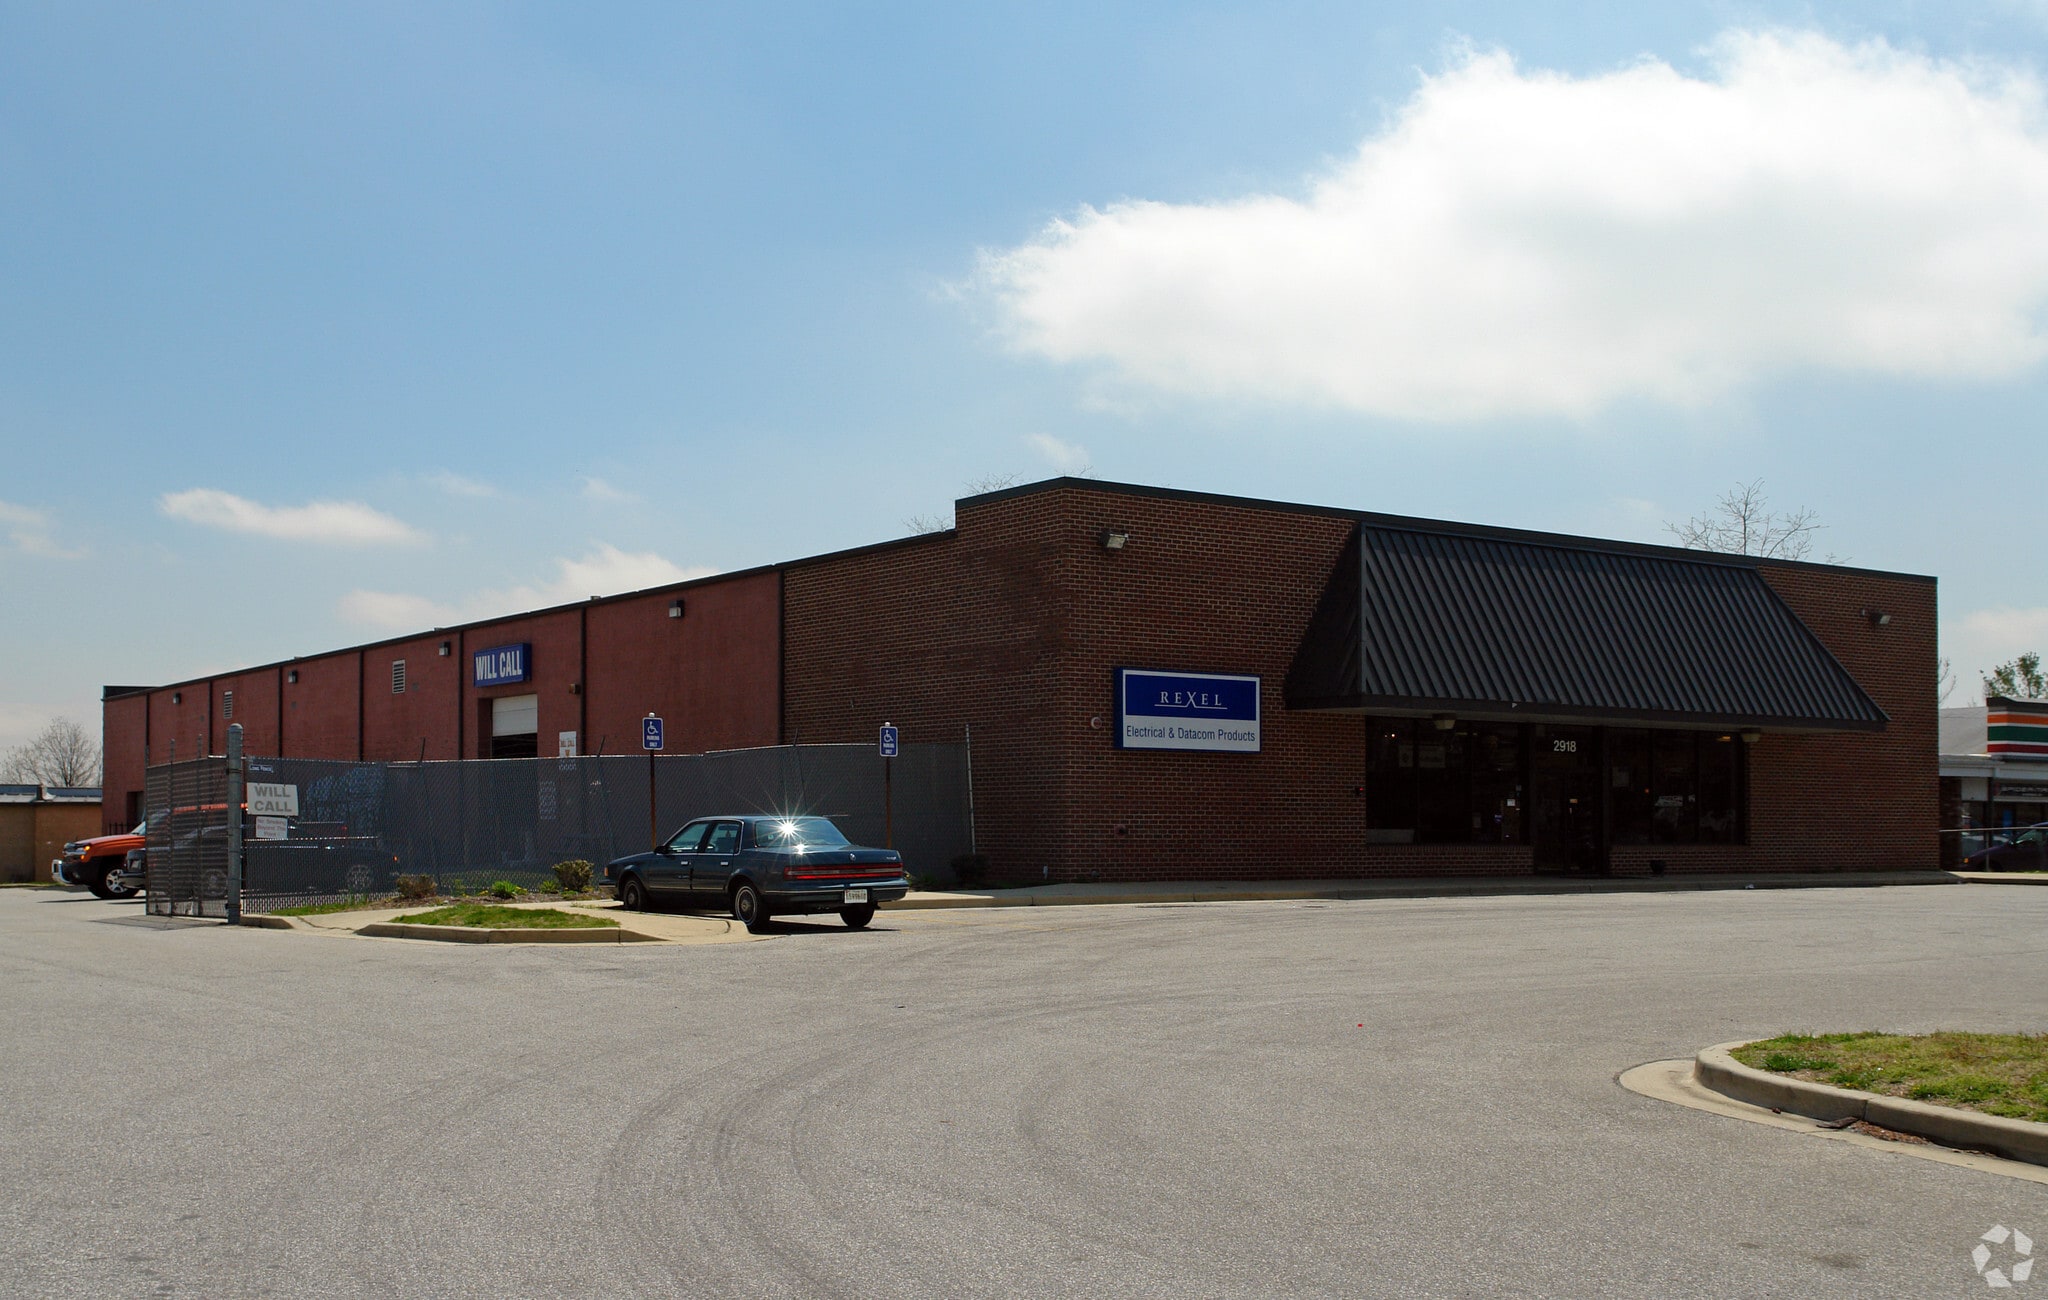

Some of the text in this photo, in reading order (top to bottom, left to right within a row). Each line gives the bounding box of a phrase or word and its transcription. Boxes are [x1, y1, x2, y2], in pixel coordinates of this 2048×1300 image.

[475, 650, 522, 680] WILL CALL
[1160, 691, 1222, 708] REXEL
[1126, 725, 1256, 742] Electrical & Datacom Products
[1553, 740, 1577, 752] 2918
[254, 785, 291, 798] WILL
[254, 801, 292, 812] CALL
